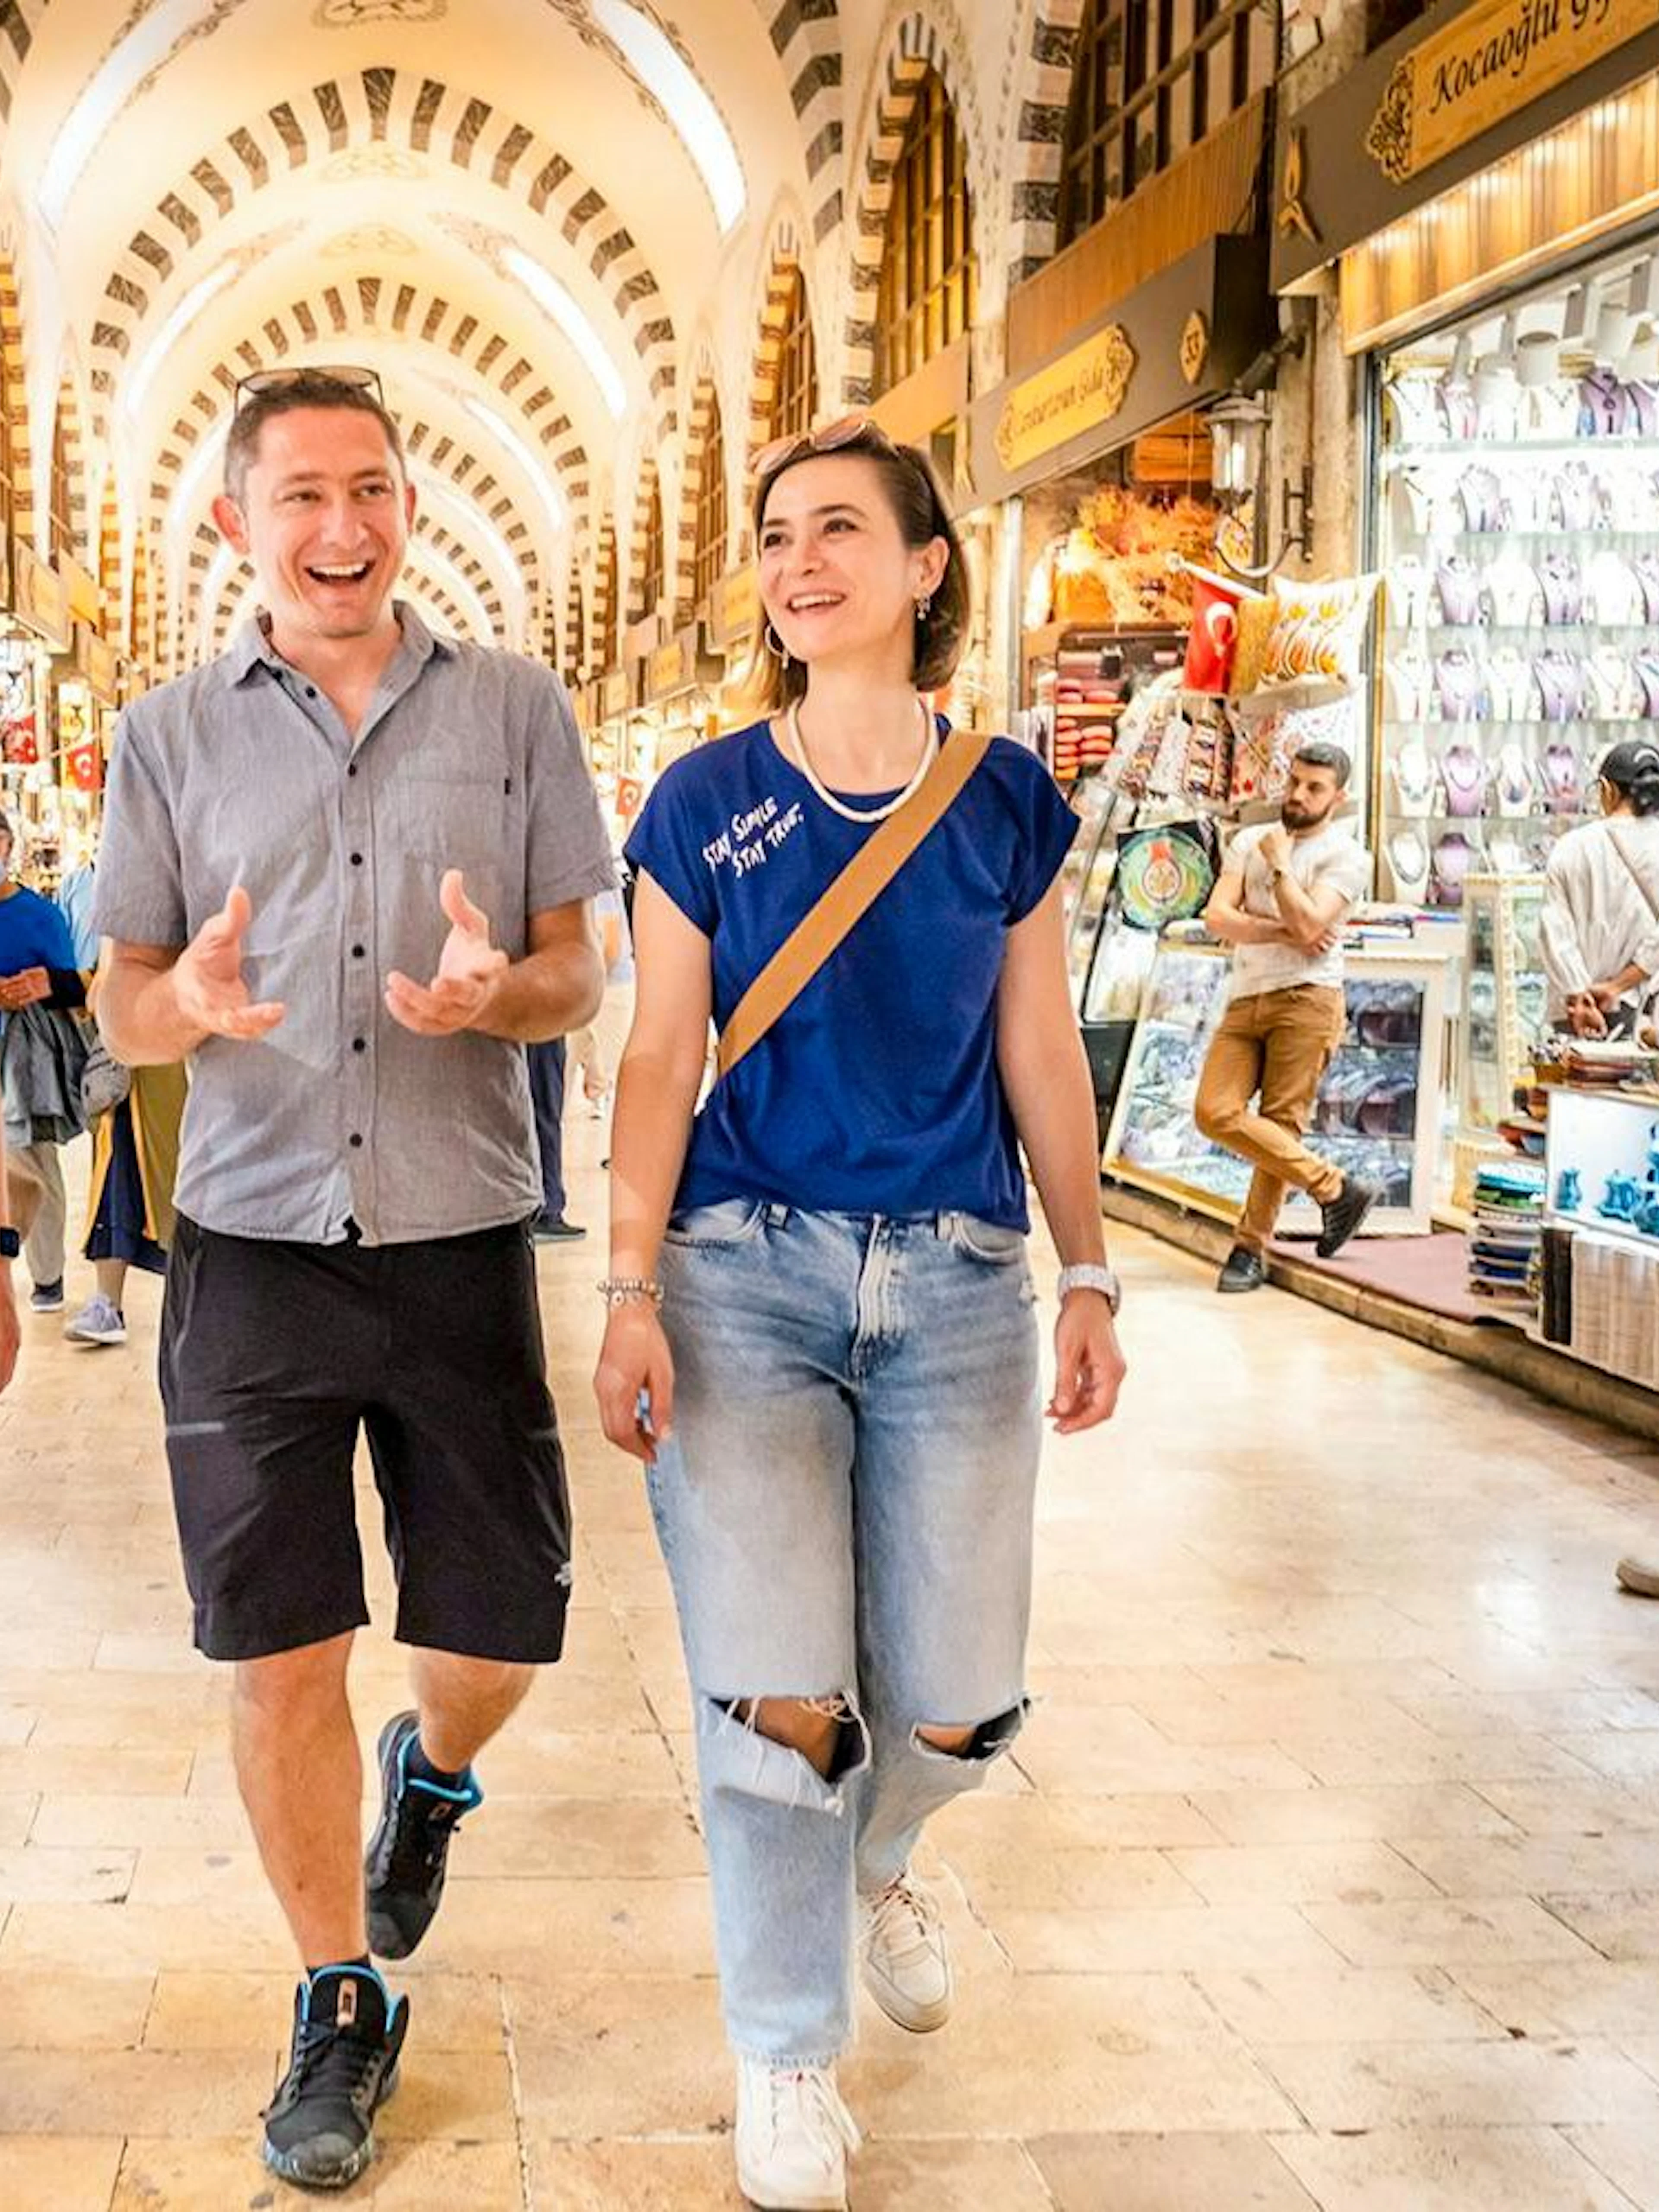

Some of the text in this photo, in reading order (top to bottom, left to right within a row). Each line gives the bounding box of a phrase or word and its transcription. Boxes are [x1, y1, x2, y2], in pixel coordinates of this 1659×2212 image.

[1430, 0, 1560, 114] Kocaoğlu
[702, 831, 732, 874] STAY
[732, 838, 767, 878] STAY
